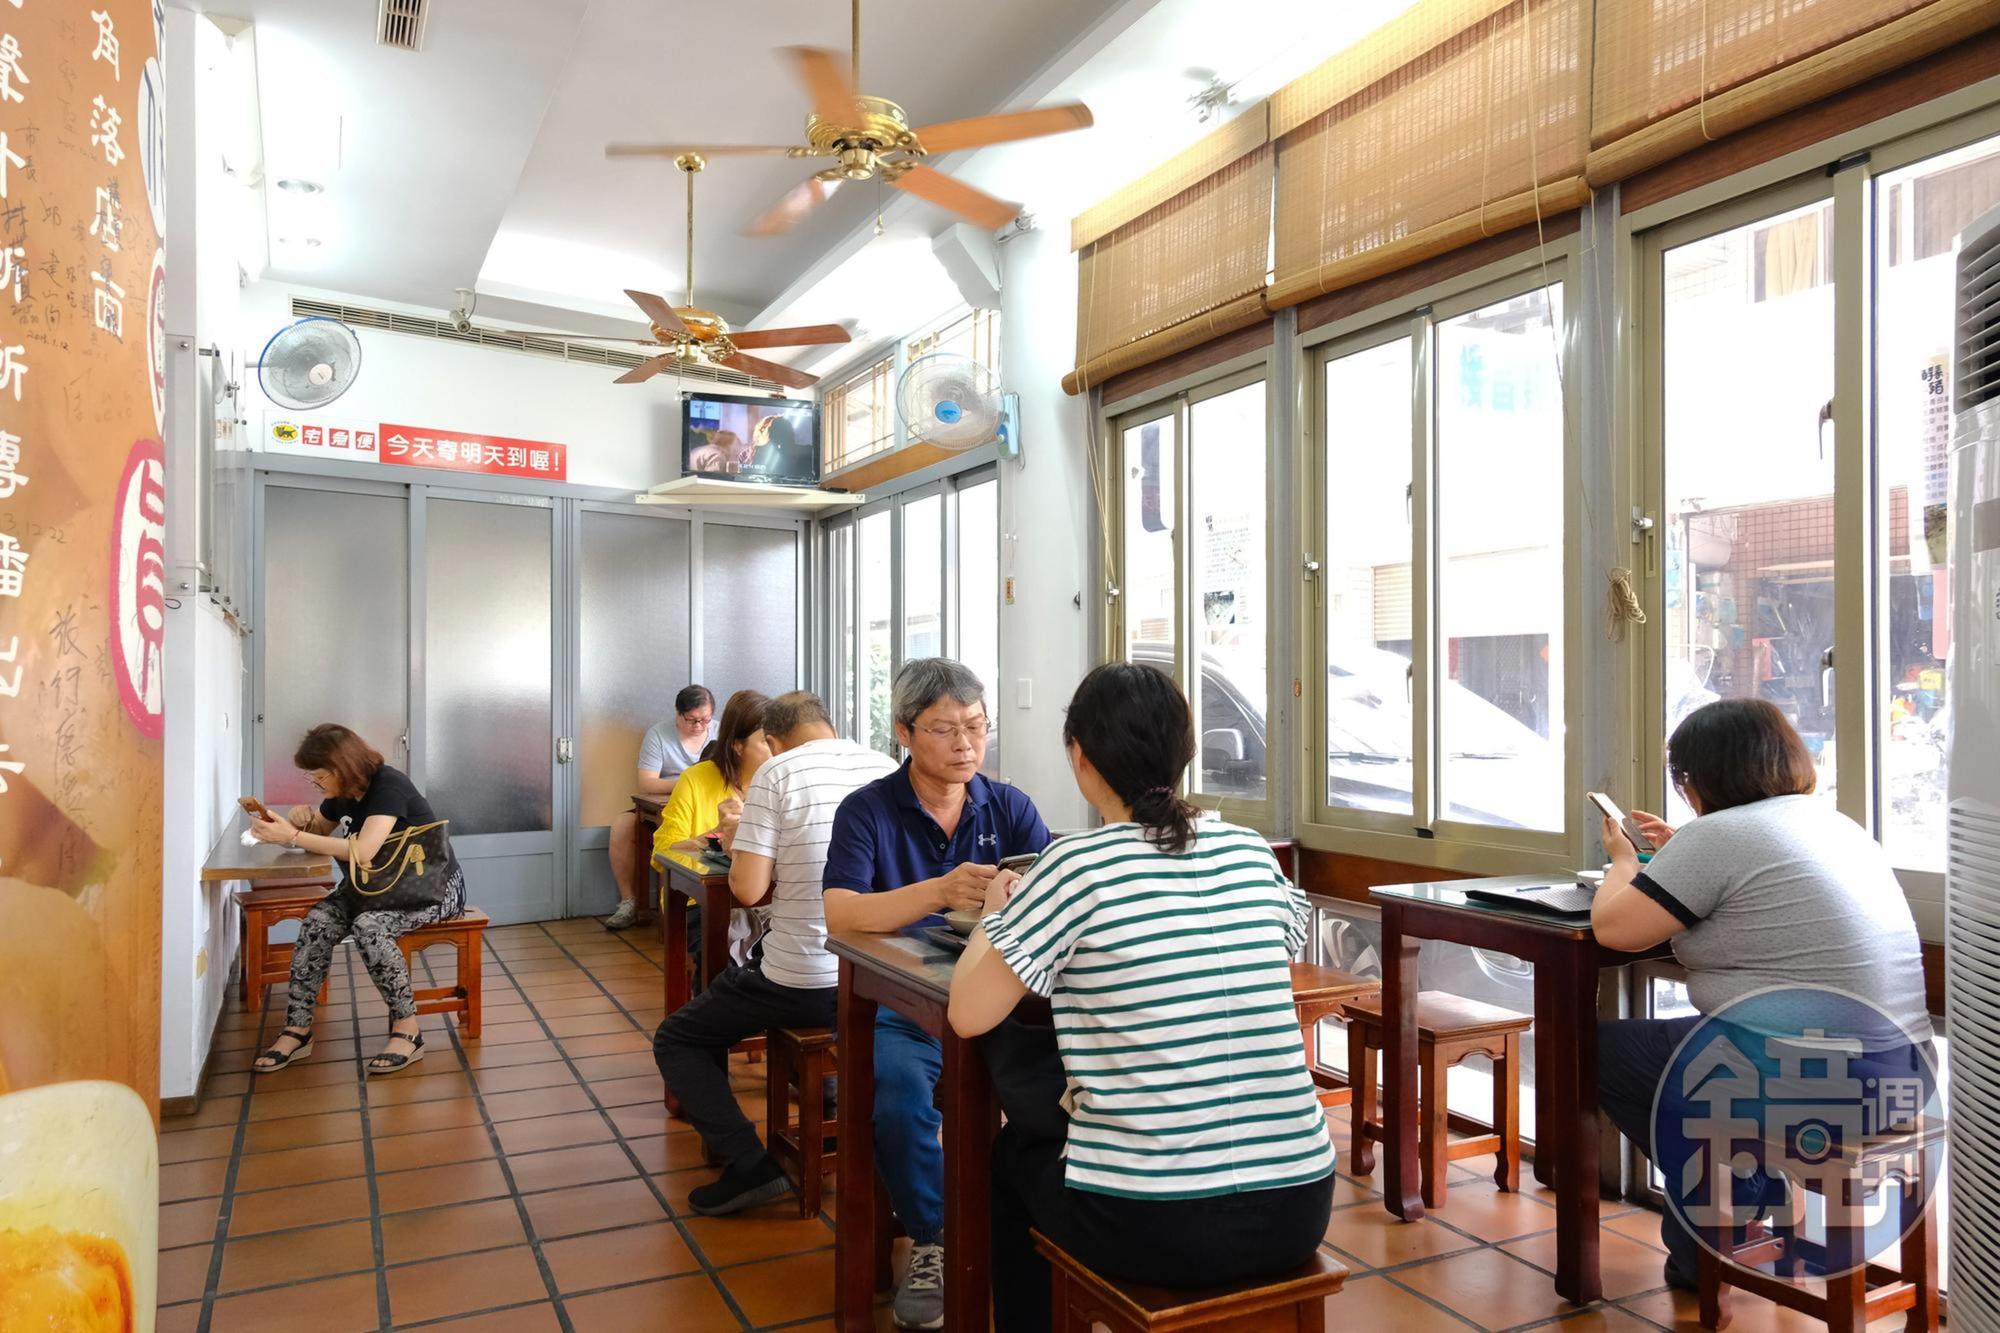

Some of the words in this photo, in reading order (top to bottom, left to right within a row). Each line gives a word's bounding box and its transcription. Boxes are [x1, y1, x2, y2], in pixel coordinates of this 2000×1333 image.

[303, 427, 375, 449] 宅急便
[387, 434, 560, 472] 今天寄明天到喔!
